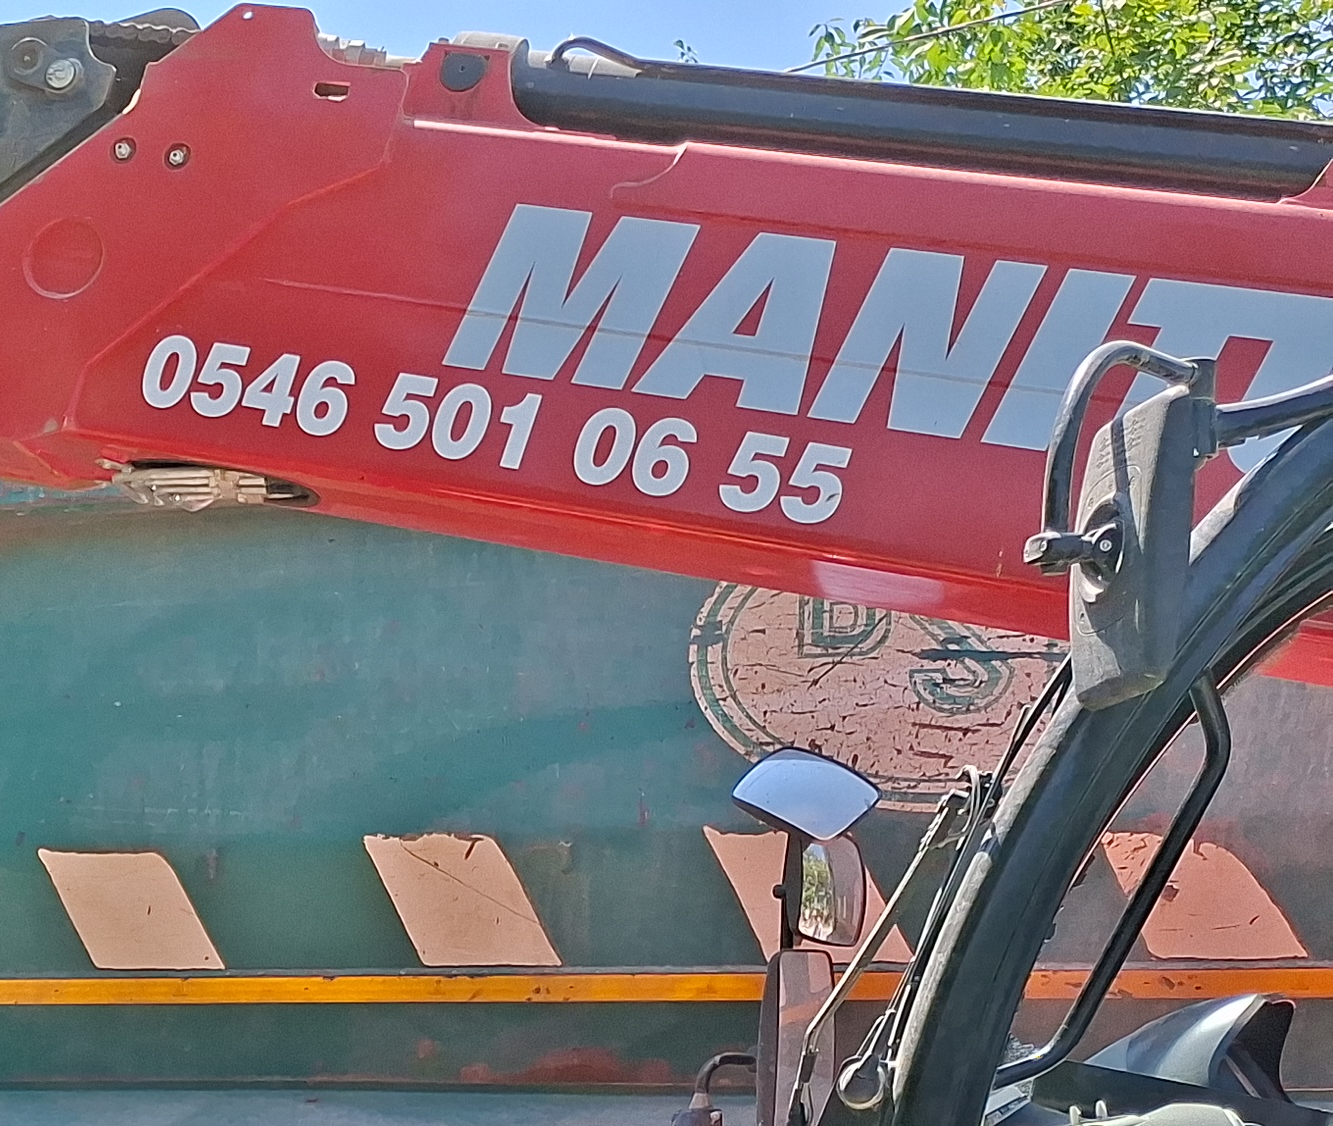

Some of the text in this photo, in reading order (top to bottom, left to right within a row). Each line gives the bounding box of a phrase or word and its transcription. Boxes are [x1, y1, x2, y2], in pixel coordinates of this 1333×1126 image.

[141, 335, 852, 525] 0546 501 06 55
